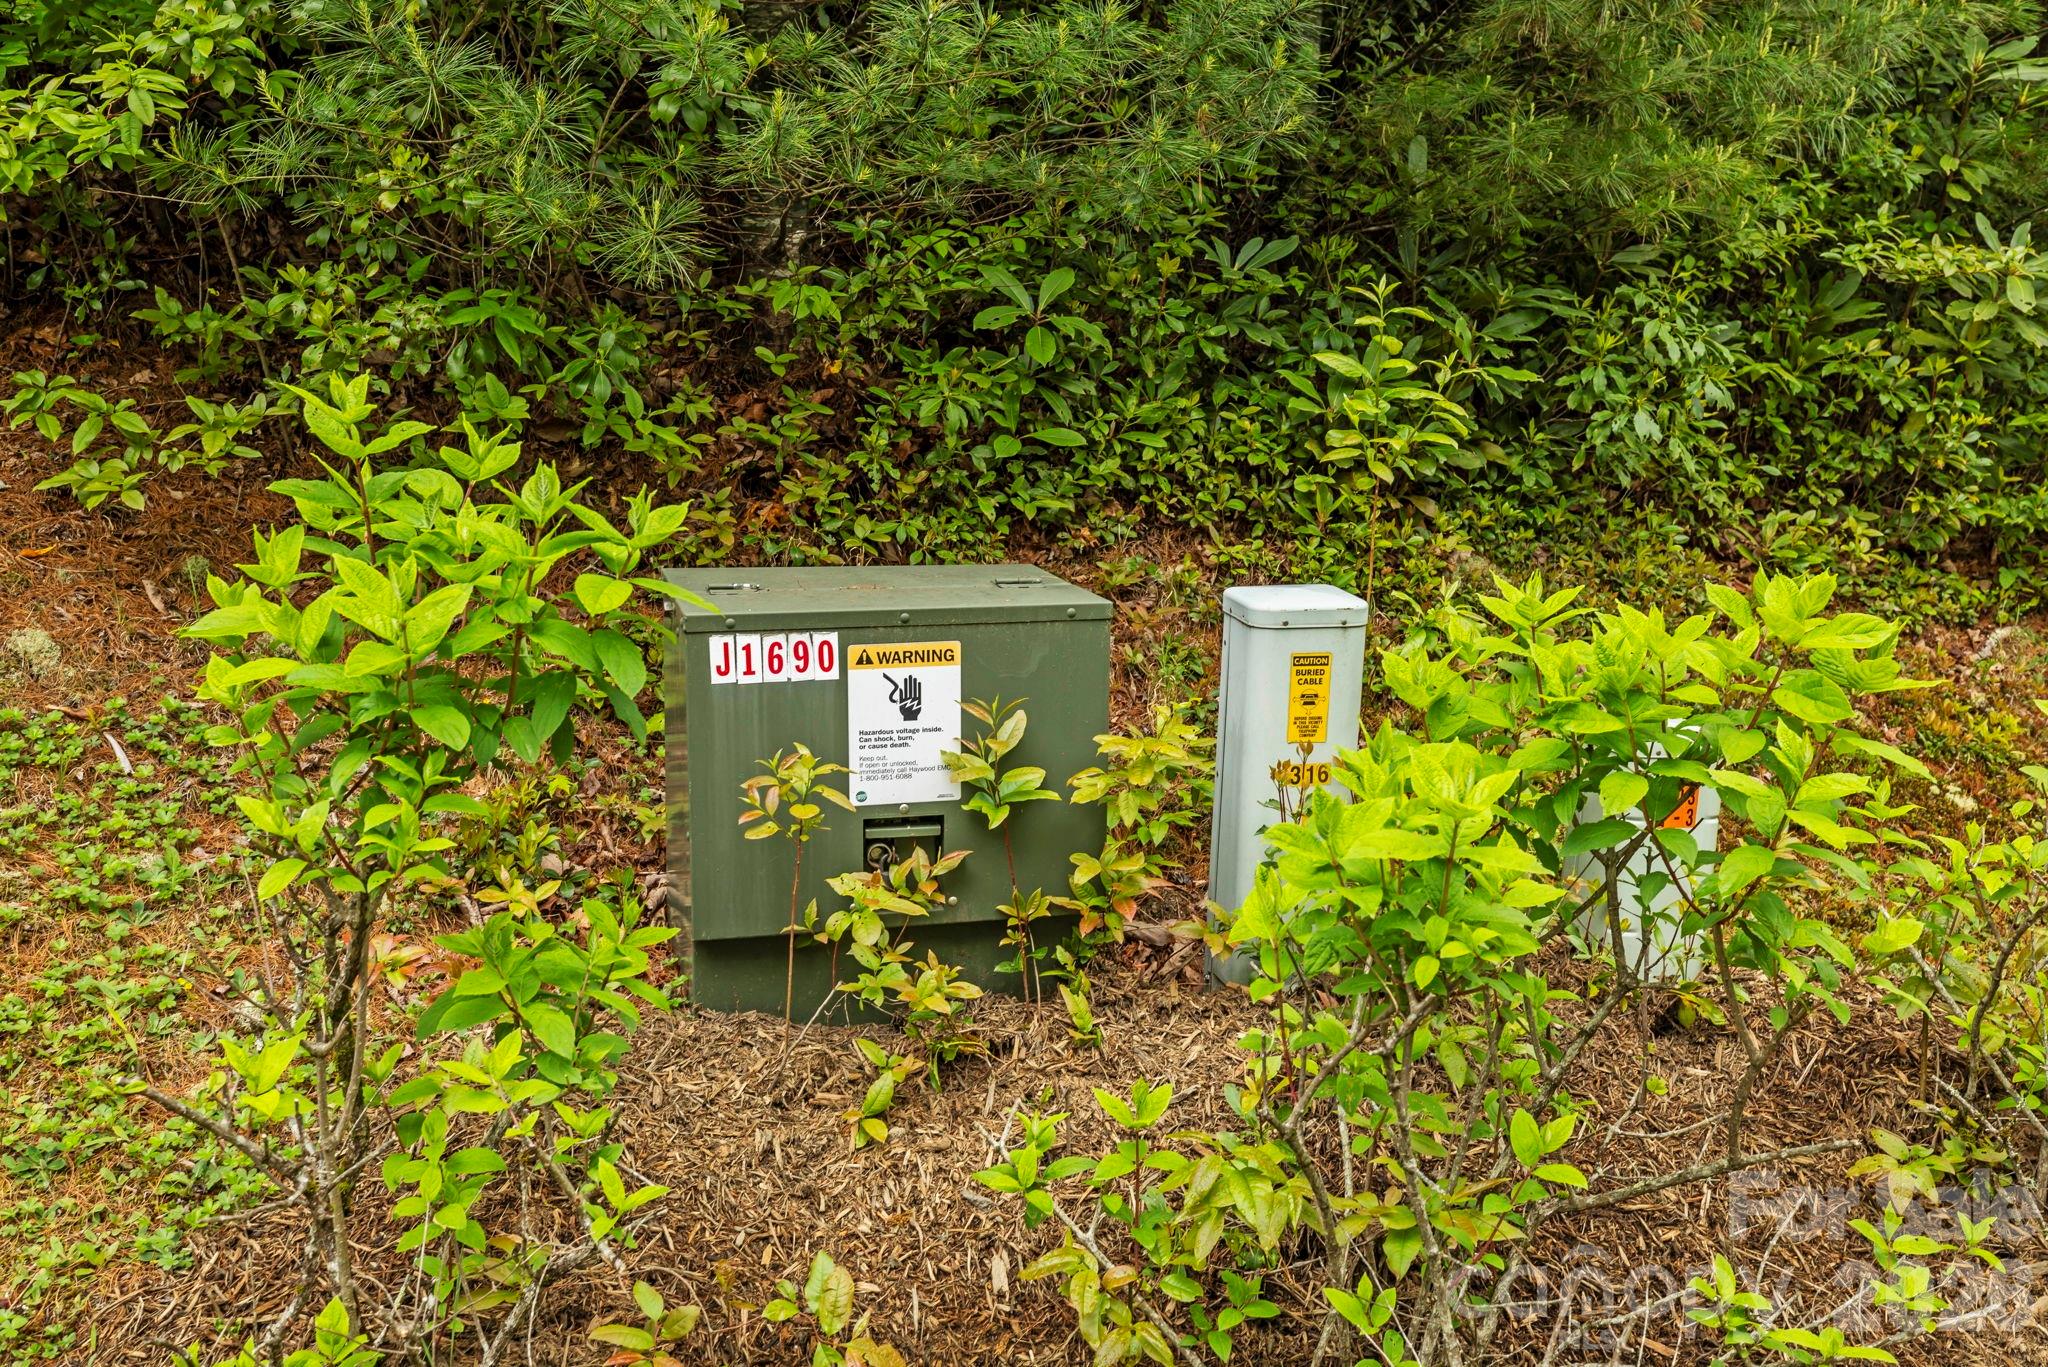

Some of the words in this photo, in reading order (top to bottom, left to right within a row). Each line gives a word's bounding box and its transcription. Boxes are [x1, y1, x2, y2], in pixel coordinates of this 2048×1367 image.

[716, 639, 834, 677] J1690
[877, 648, 955, 665] WARNING
[1294, 657, 1328, 665] CAUTION
[1296, 668, 1325, 676] BURIED
[1297, 677, 1323, 685] CABLE
[860, 773, 913, 782] 1-800-951-6088
